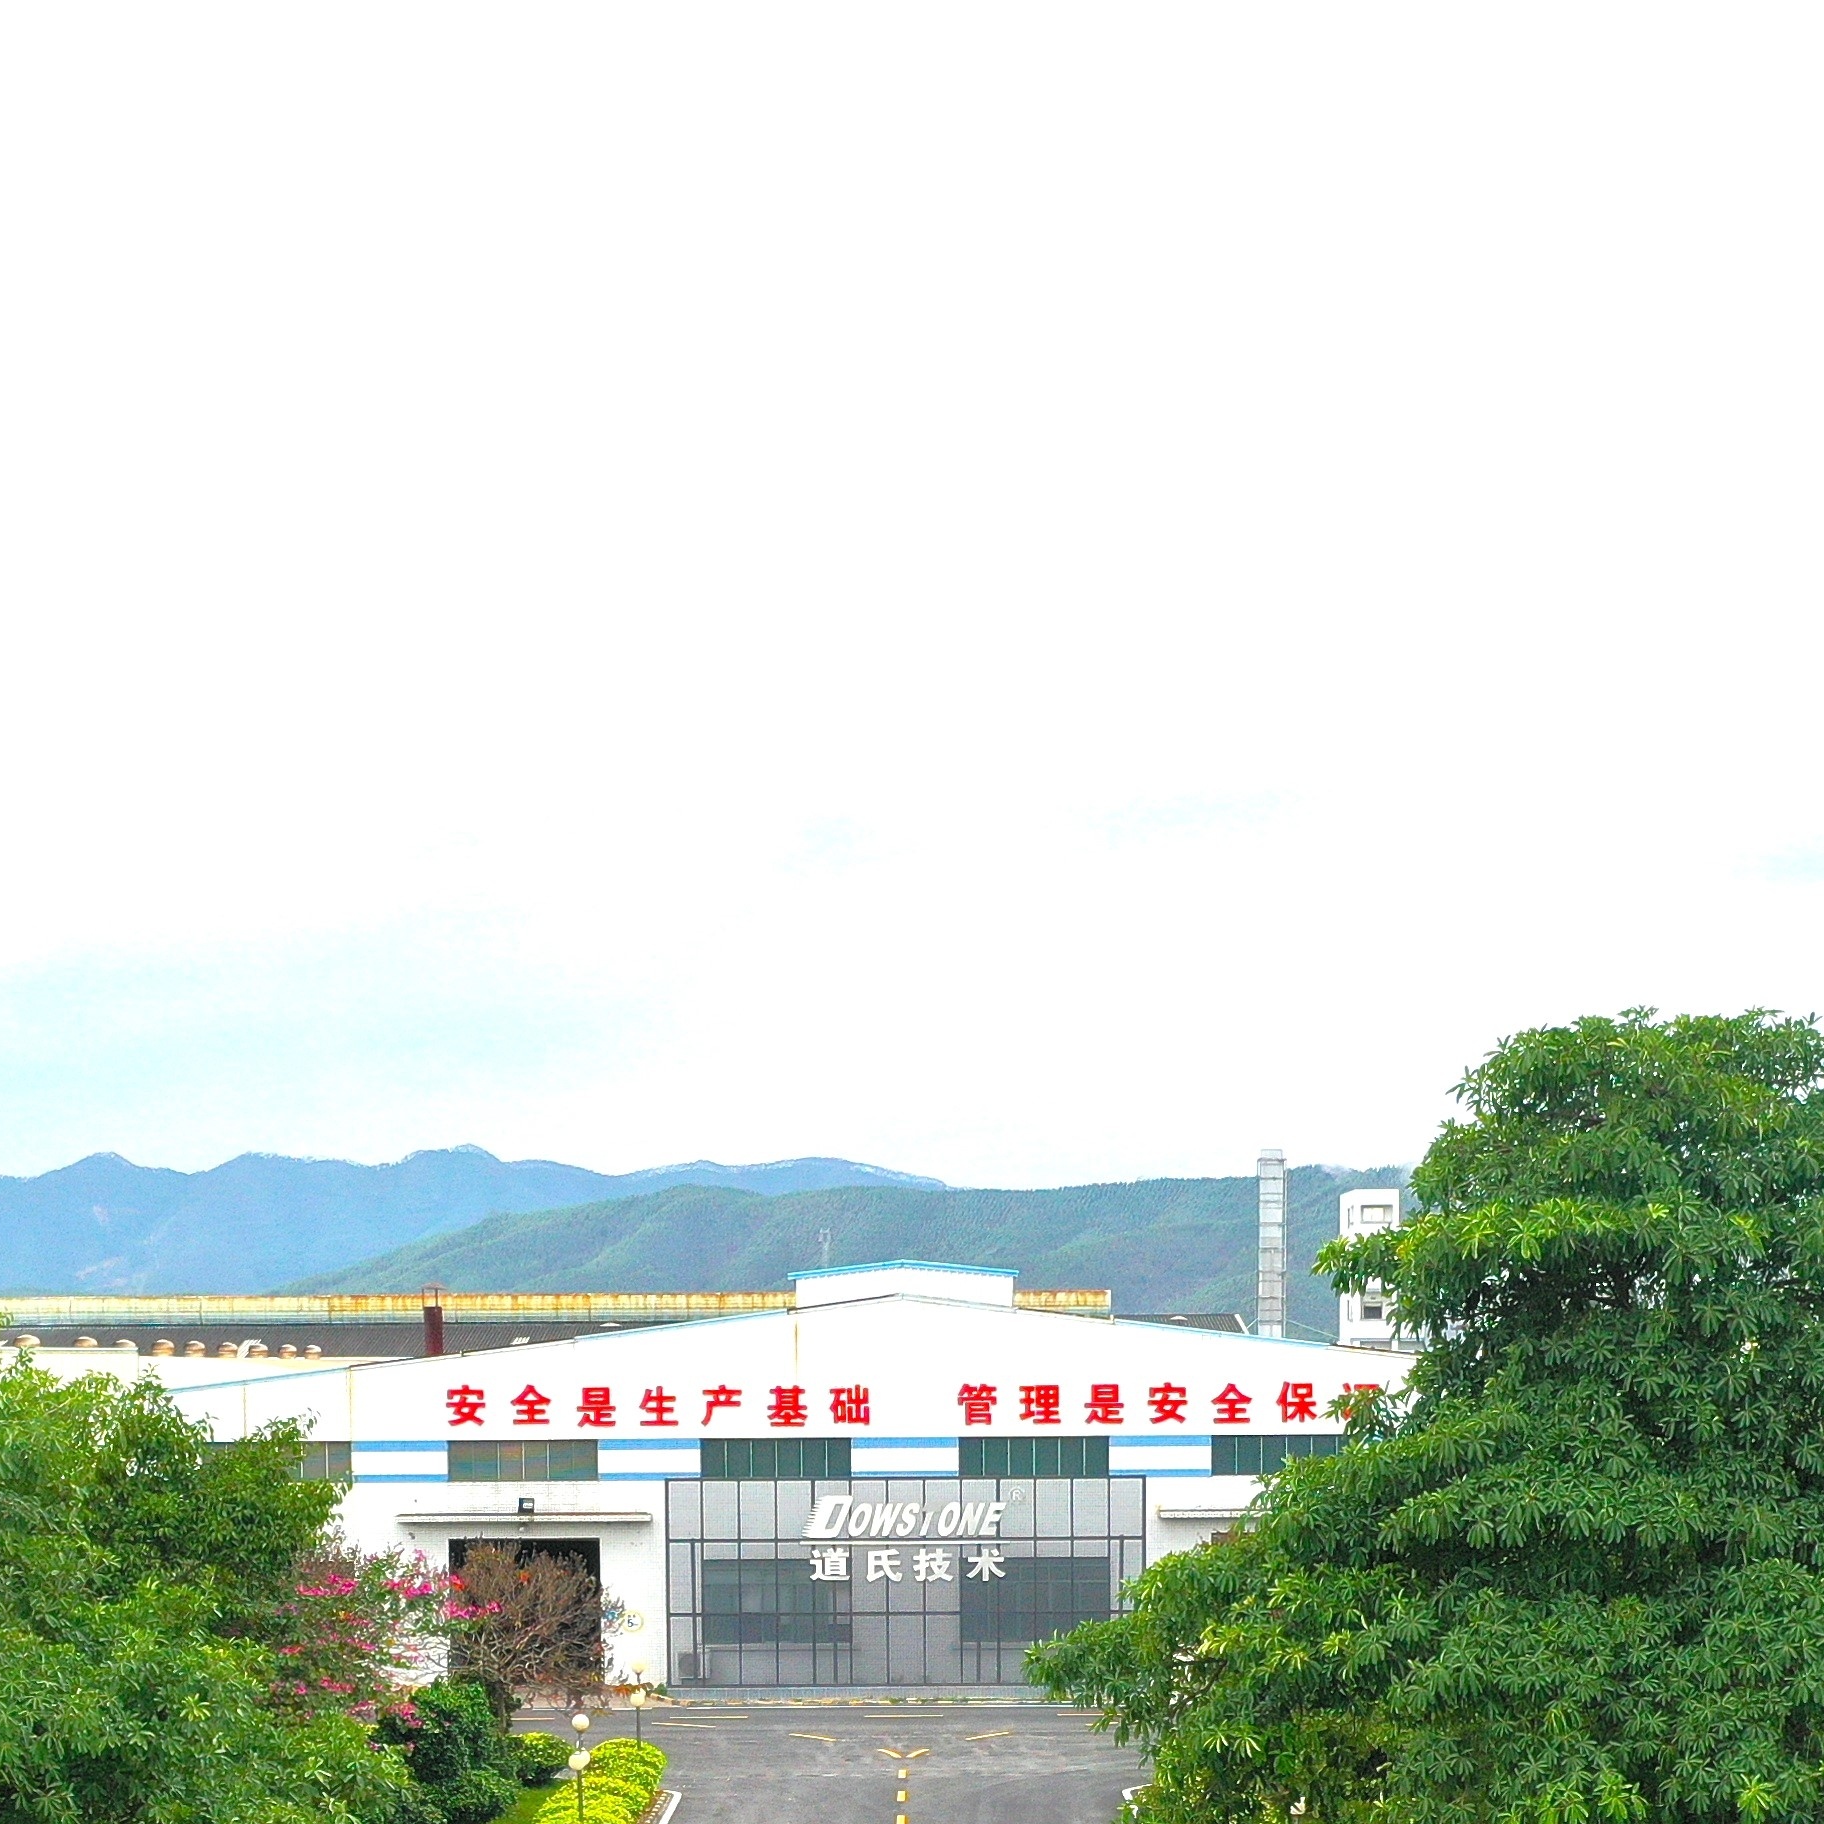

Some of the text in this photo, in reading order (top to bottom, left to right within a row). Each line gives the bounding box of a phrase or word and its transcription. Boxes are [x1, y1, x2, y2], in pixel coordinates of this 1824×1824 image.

[446, 1384, 871, 1428] 安全是生产基础
[809, 1547, 1006, 1583] 道氏技术
